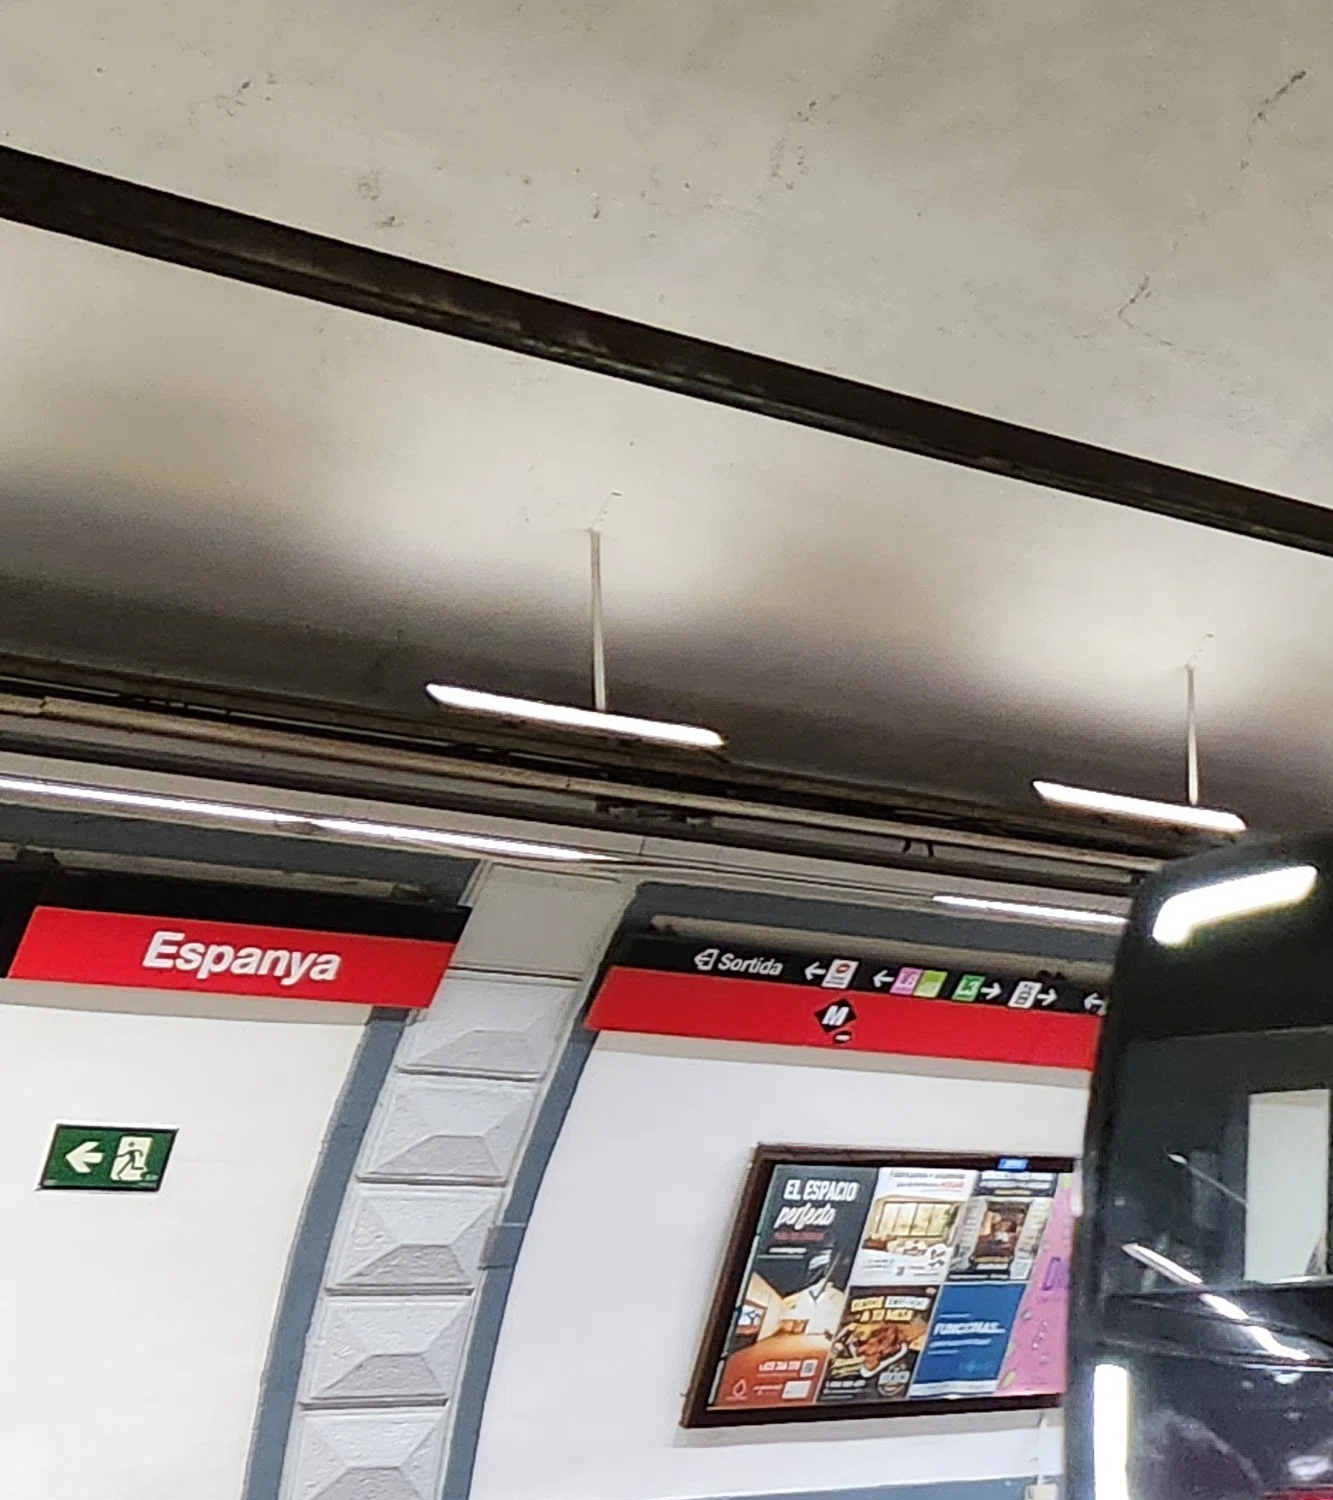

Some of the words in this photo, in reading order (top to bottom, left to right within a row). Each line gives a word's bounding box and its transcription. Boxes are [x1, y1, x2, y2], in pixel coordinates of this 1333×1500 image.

[142, 931, 342, 986] Espanya
[717, 953, 784, 976] Sortida
[821, 1005, 849, 1026] M
[783, 1179, 802, 1200] EL
[803, 1179, 860, 1201] ESPACIO
[773, 1202, 837, 1230] perfecto
